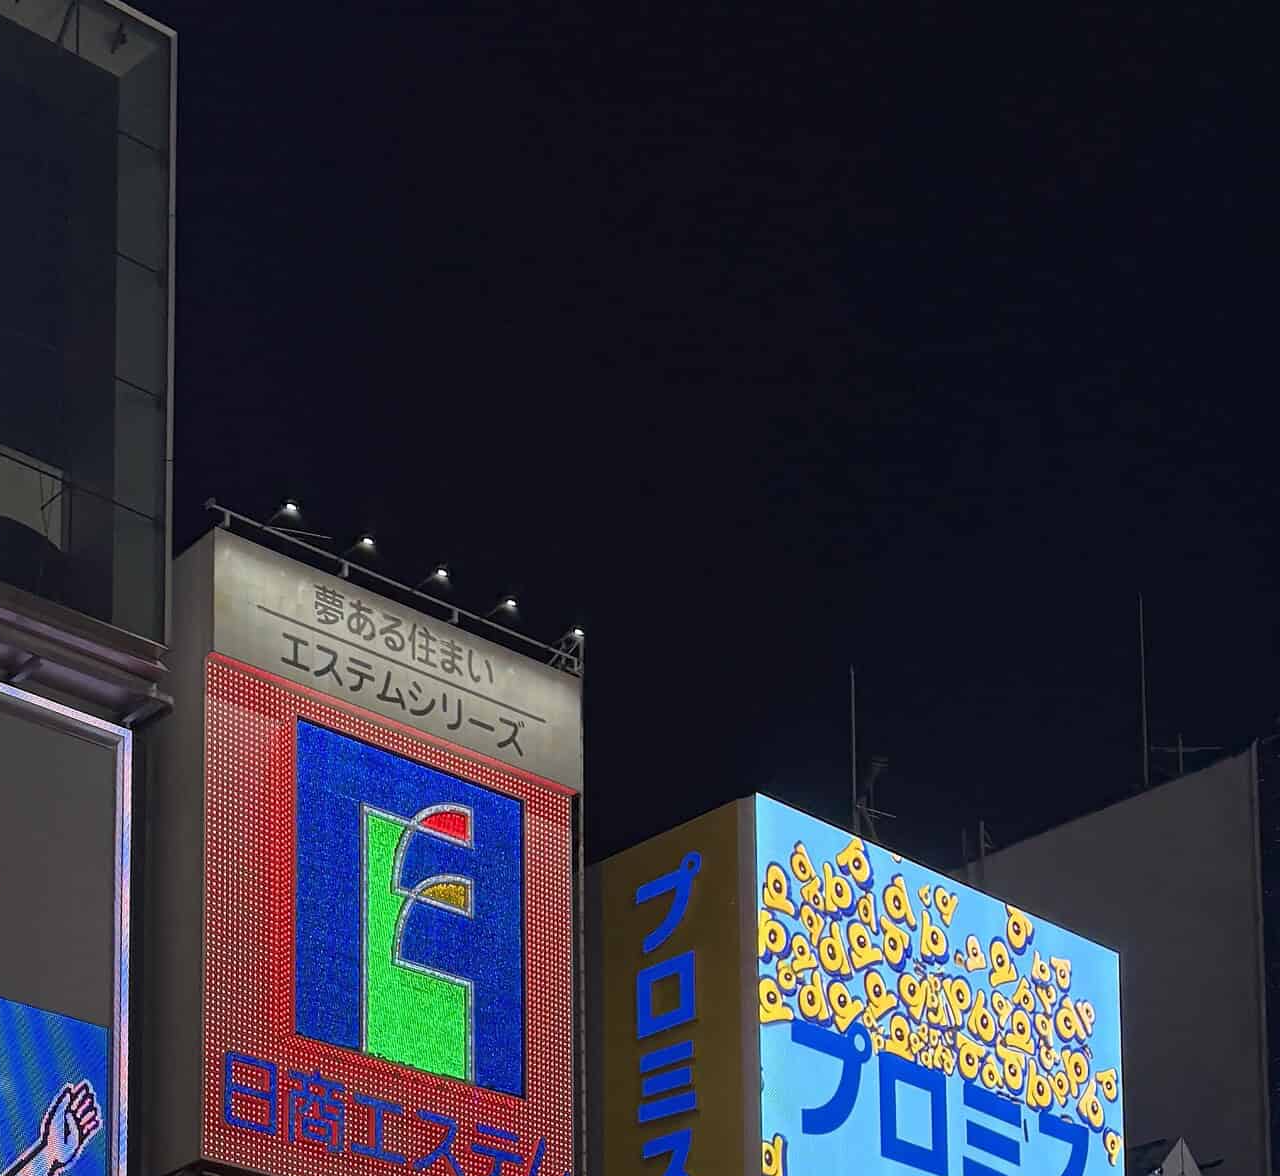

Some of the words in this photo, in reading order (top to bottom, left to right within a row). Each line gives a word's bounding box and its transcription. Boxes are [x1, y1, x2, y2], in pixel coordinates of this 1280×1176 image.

[312, 583, 496, 686] 夢ある住まい
[280, 631, 525, 758] エステムシリーズ
